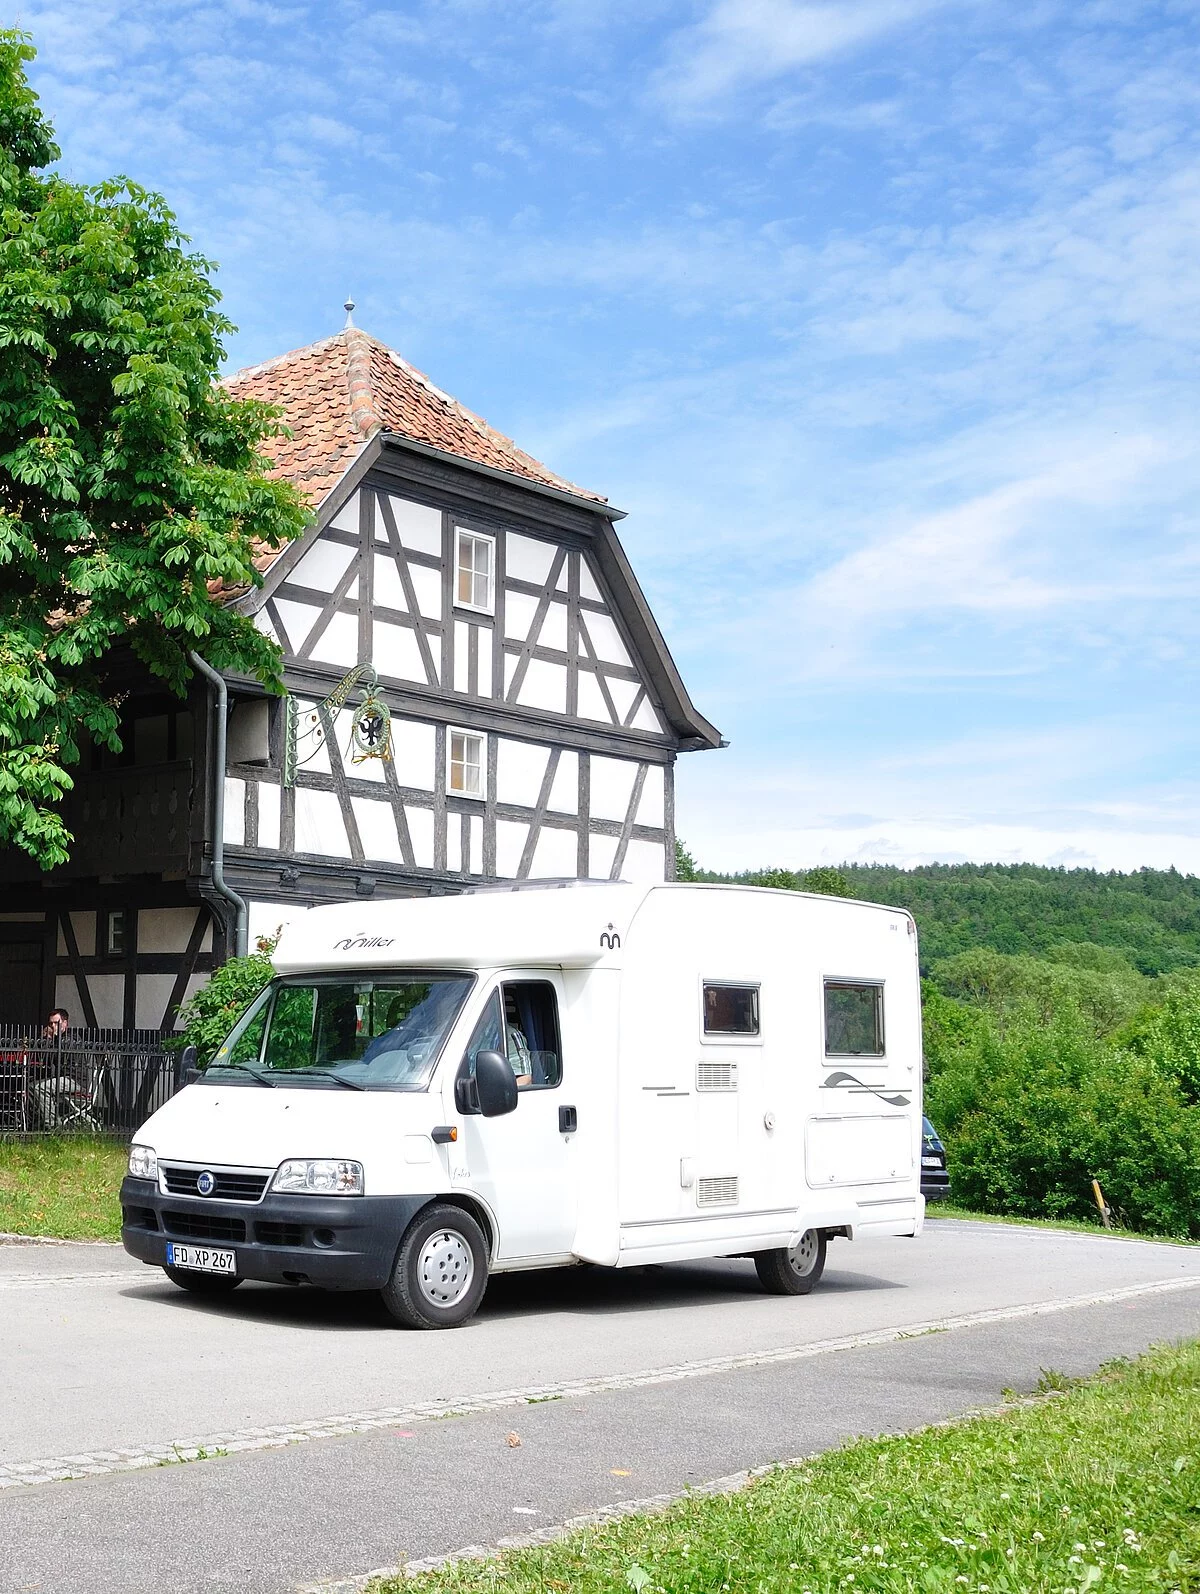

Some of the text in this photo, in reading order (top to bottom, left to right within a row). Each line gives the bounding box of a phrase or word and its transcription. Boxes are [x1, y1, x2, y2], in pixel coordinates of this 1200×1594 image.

[173, 1247, 233, 1269] FD XP 267
